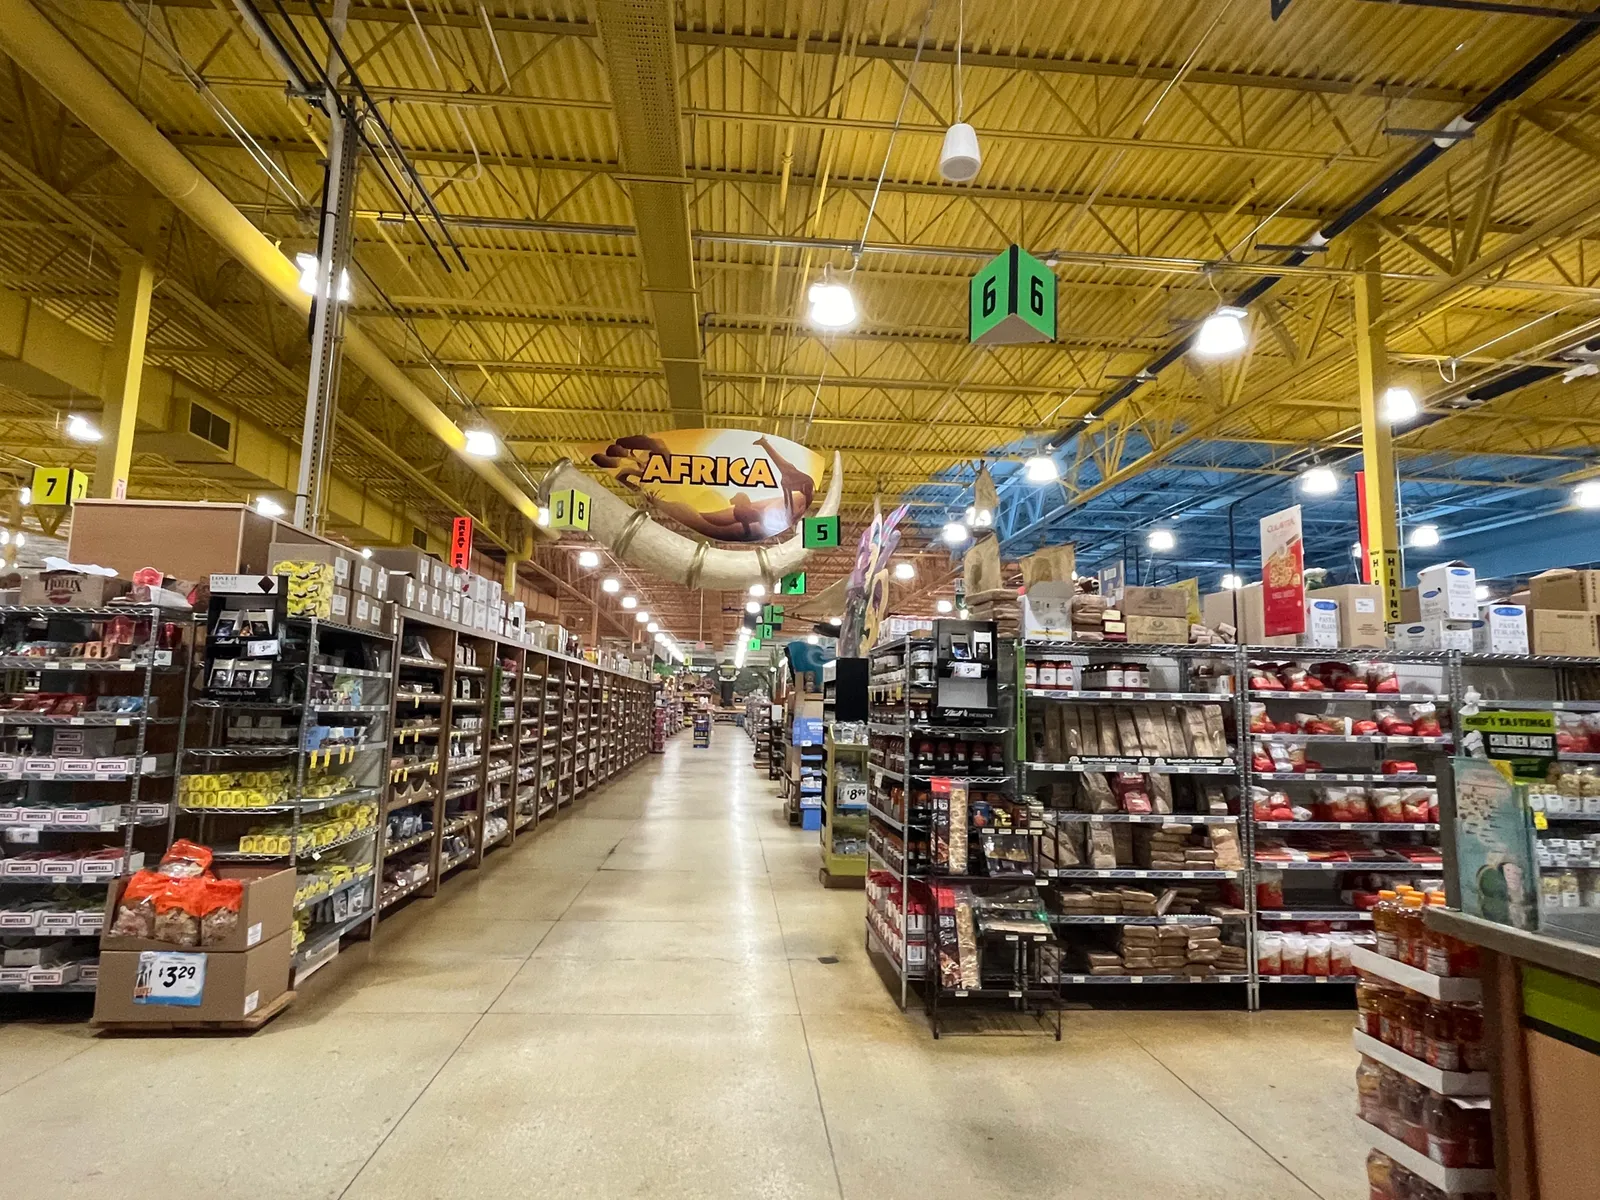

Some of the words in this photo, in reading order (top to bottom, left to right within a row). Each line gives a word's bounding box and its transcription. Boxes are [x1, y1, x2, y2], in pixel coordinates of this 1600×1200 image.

[983, 275, 996, 318] 6
[1031, 275, 1044, 316] 6
[640, 453, 778, 488] AFRICA
[46, 478, 57, 496] 7
[578, 501, 585, 520] 8
[816, 524, 828, 541] 5
[789, 578, 798, 590] 4
[1387, 557, 1399, 619] HIRING
